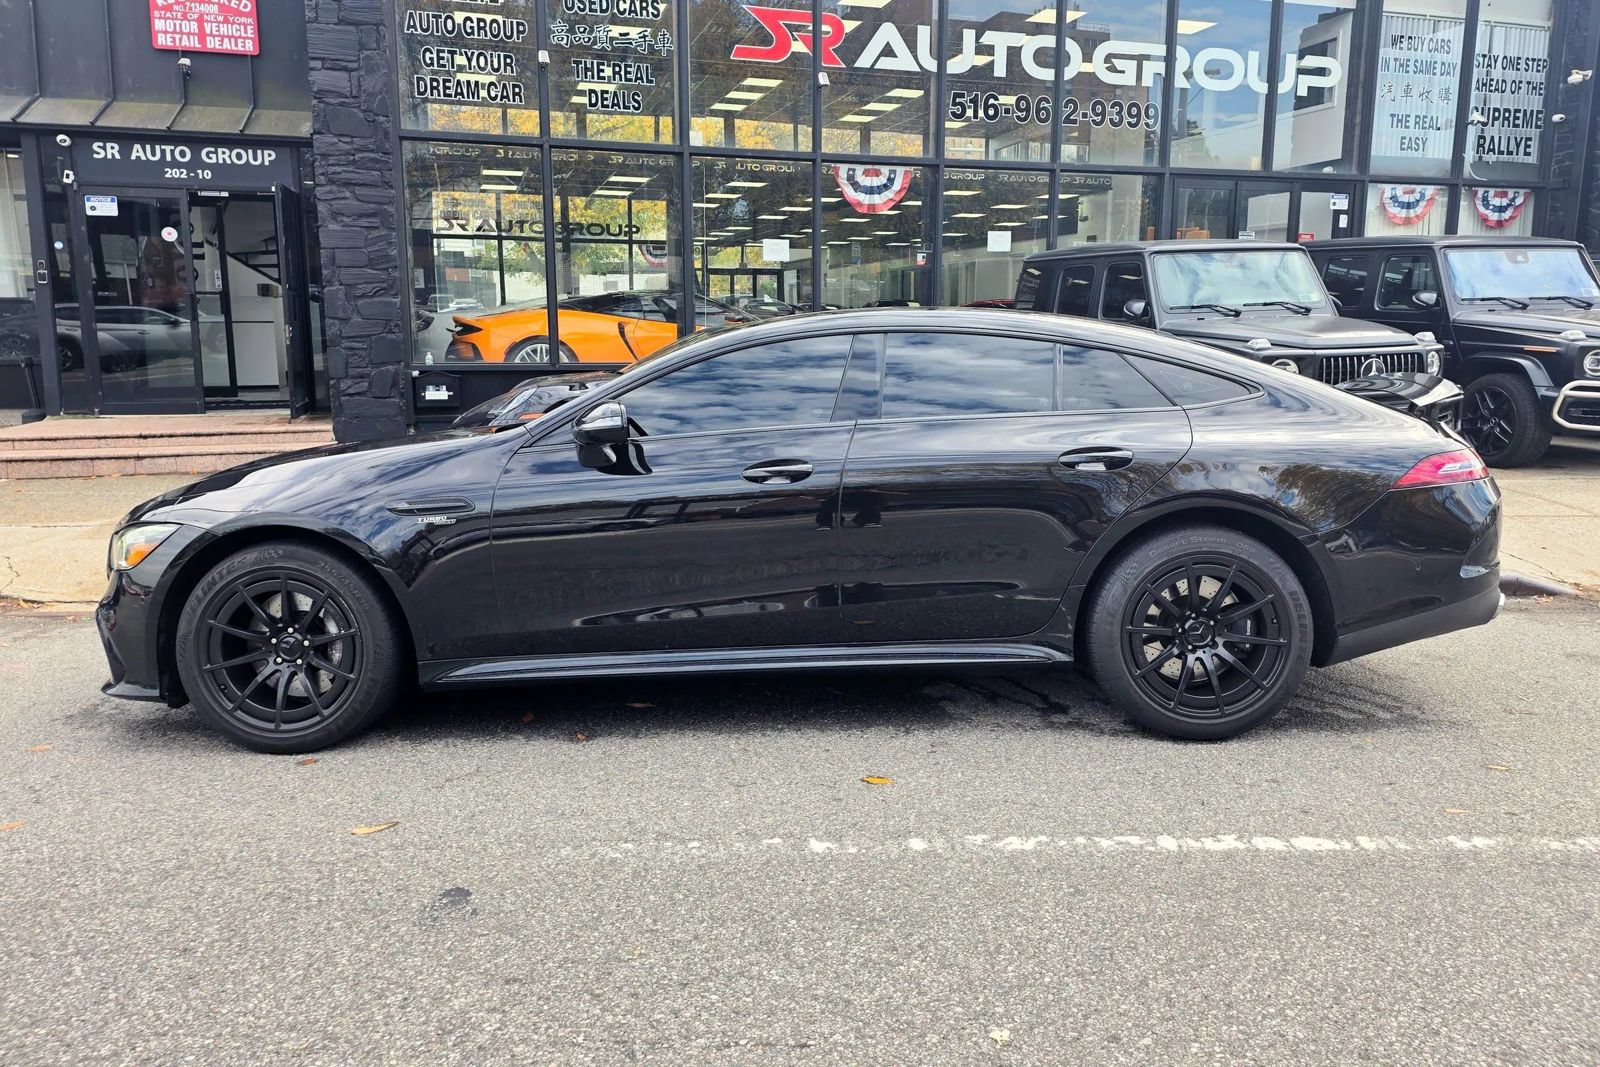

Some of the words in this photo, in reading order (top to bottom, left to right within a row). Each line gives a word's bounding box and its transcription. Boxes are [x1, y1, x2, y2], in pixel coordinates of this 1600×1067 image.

[153, 10, 183, 19] STATE
[204, 14, 224, 22] NEW
[228, 16, 254, 24] YORK
[563, 0, 611, 15] USED
[615, 0, 661, 19] CARS
[154, 18, 199, 33] MOTOR
[204, 22, 255, 37] VEHICLE
[404, 10, 458, 37] AUTO
[461, 16, 528, 42] GROUP
[550, 18, 674, 56] 高品質二手車
[157, 33, 202, 48] RETAIL
[206, 36, 254, 51] DEALER
[730, 4, 846, 68] SR
[853, 22, 1083, 81] AUTO
[1092, 39, 1342, 97] GROUP
[1390, 33, 1405, 51] WE
[1406, 34, 1426, 53] BUY
[1427, 37, 1452, 55] CARS
[421, 45, 459, 71] GET
[462, 49, 516, 75] YOUR
[571, 58, 608, 82] THE
[611, 61, 656, 85] REAL
[1380, 56, 1391, 73] IN
[1393, 57, 1411, 75] THE
[1412, 58, 1439, 77] SAME
[1440, 61, 1458, 78] DAY
[1475, 52, 1498, 70] STAY
[1501, 54, 1522, 73] ONE
[1523, 56, 1549, 75] STEP
[414, 75, 481, 101] DREAM
[485, 81, 525, 104] CAR
[1473, 78, 1507, 95] AHEAD
[1509, 78, 1524, 96] OF
[1525, 79, 1545, 97] THE
[587, 88, 643, 112] DEALS
[1389, 113, 1410, 129] THE
[1413, 114, 1441, 131] REAL
[92, 141, 121, 160] SR
[130, 143, 191, 162] AUTO
[201, 147, 277, 166] GROUP
[1399, 135, 1428, 153] EASY
[1475, 134, 1534, 157] RALLYE
